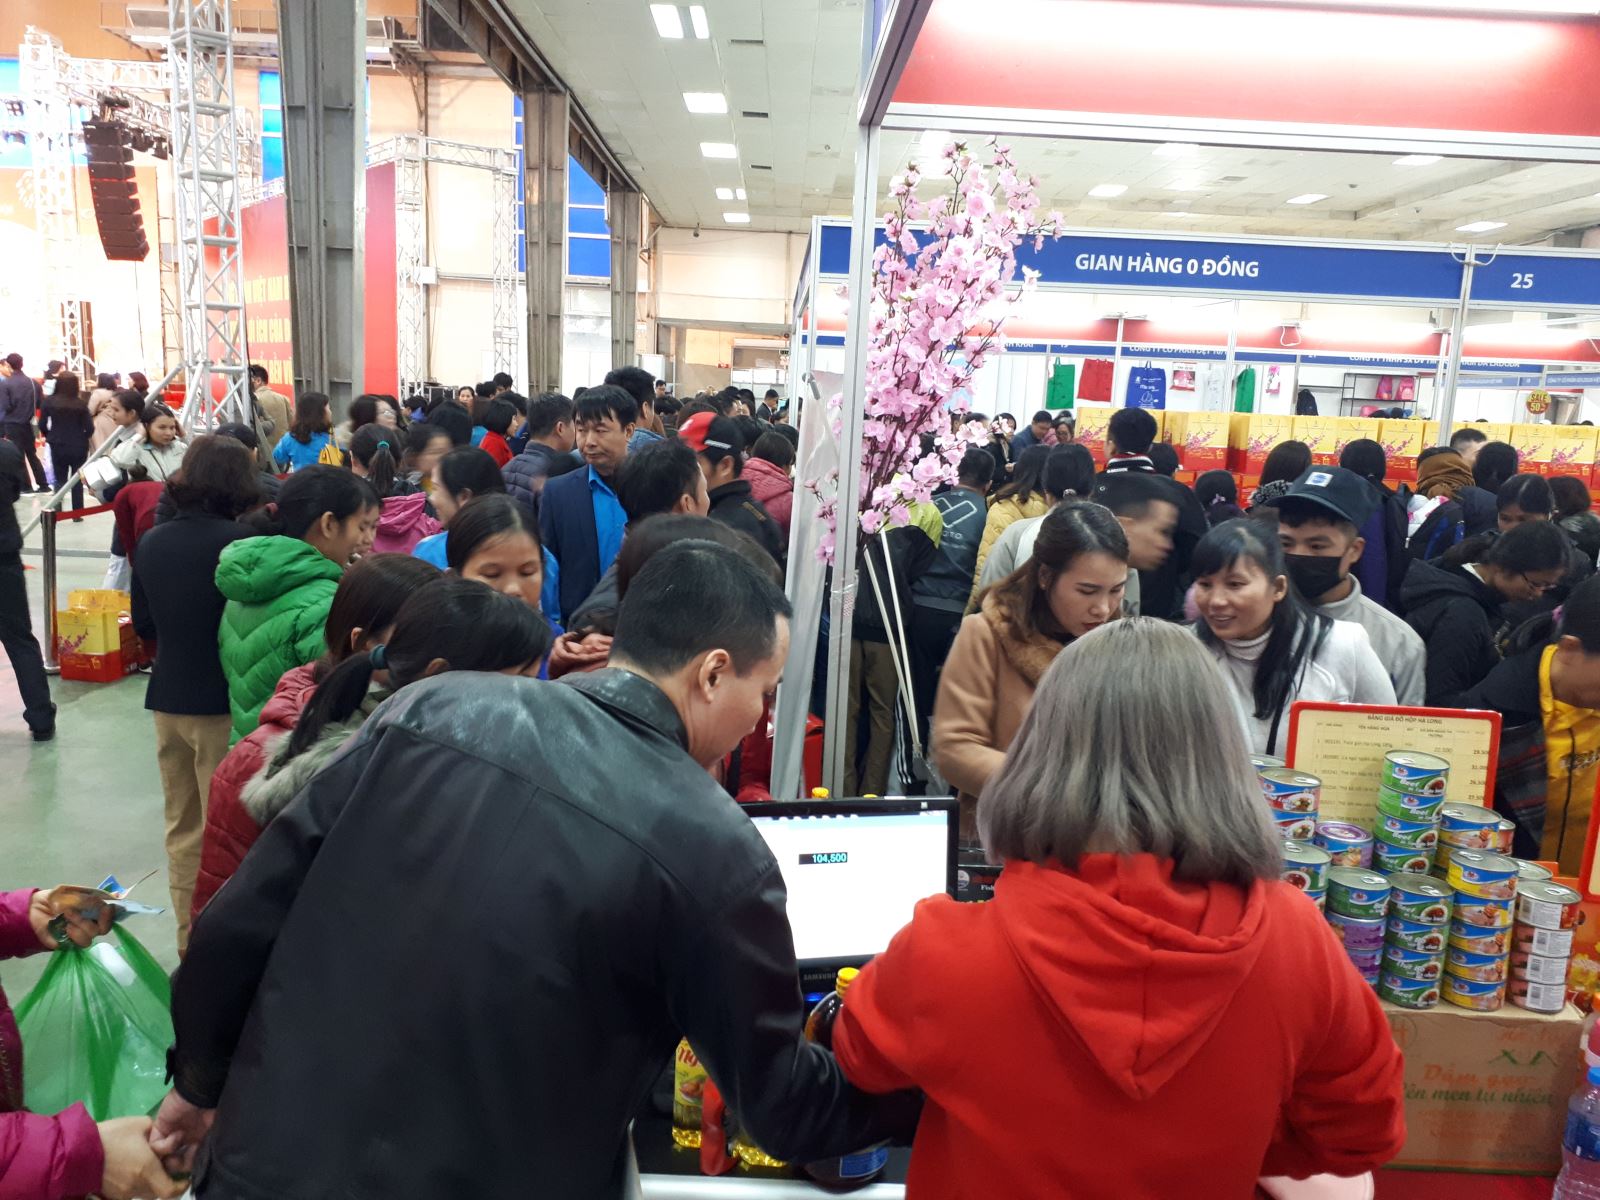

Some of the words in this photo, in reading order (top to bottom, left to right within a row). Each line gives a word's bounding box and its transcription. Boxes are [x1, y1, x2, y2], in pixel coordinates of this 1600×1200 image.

[1075, 253, 1123, 272] GIAN
[1127, 252, 1183, 274] HÀNG
[1186, 258, 1199, 275] 0
[1201, 254, 1260, 278] ĐỒNG
[1510, 272, 1535, 289] 25
[811, 853, 847, 864] 104,500
